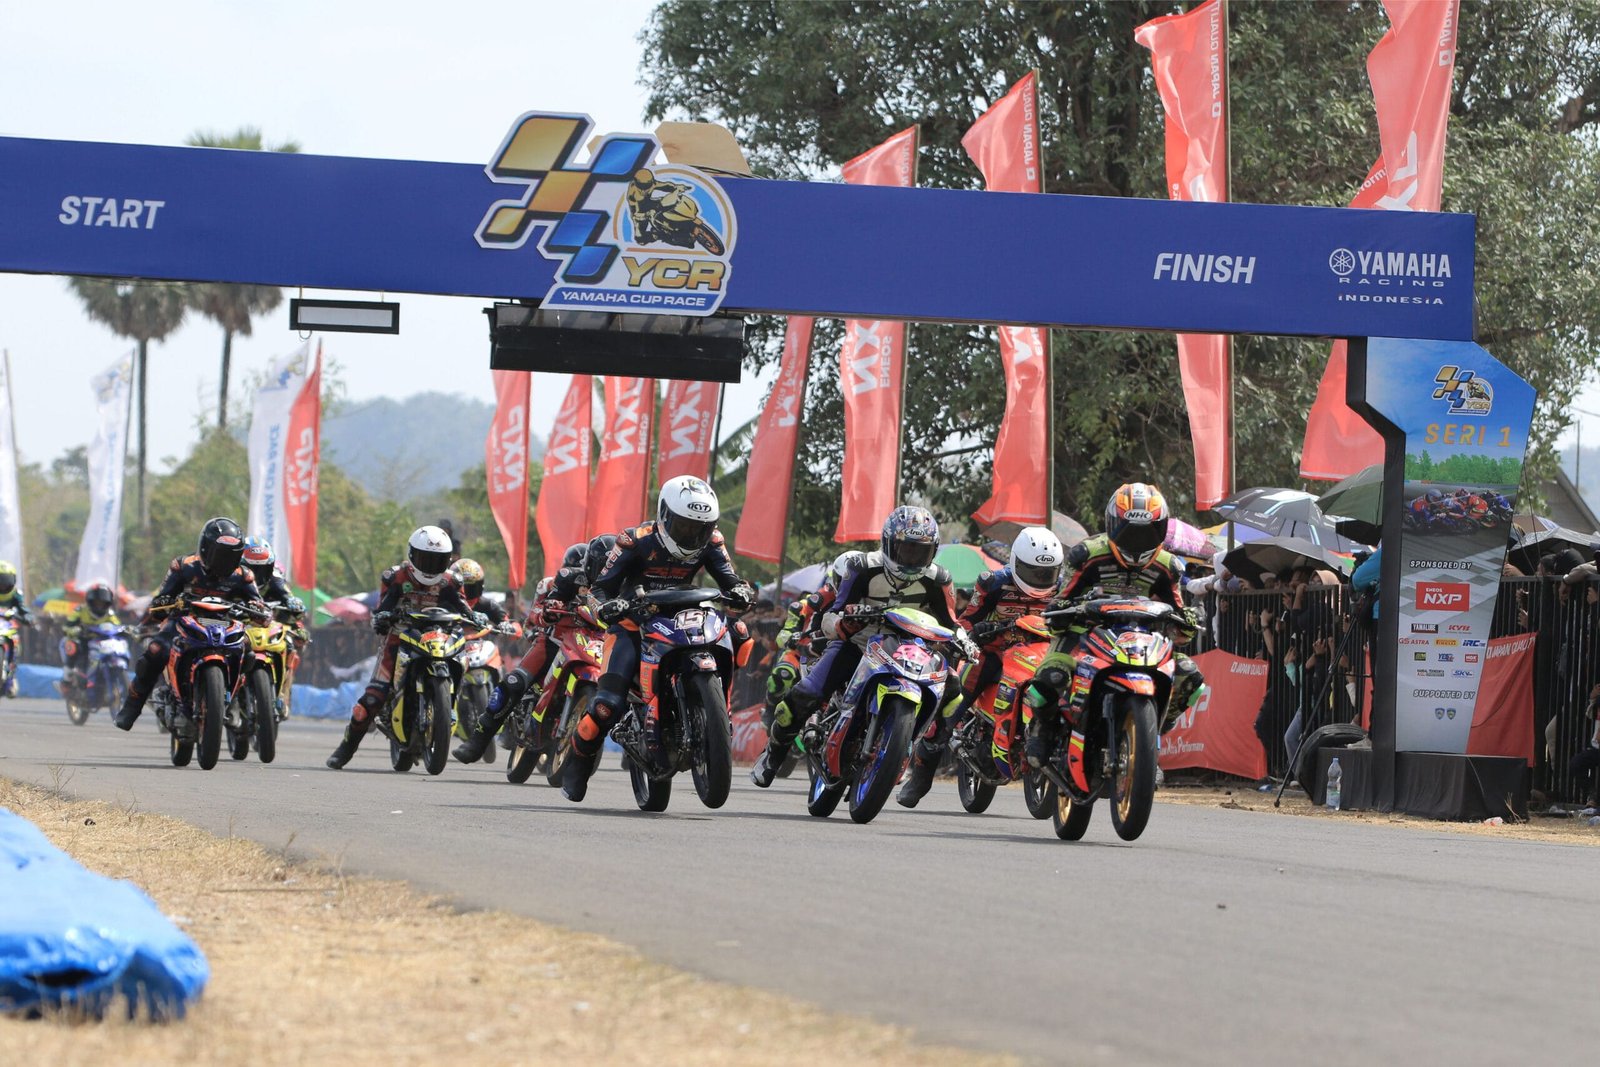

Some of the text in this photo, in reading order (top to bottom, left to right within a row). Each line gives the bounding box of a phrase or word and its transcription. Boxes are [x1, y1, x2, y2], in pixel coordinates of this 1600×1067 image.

[58, 195, 165, 229] START
[1153, 252, 1256, 284] FINISH
[1357, 250, 1451, 278] YAMAHA
[621, 256, 726, 291] YCR
[1338, 277, 1444, 288] RACING
[561, 291, 706, 307] YAMAHA CUP RACE
[1424, 423, 1512, 447] SERI 1
[1037, 555, 1054, 563] Arai
[1410, 560, 1472, 570] SPONSORED BY
[1423, 593, 1463, 605] NXP
[1413, 689, 1475, 700] SUPPORTED BY
